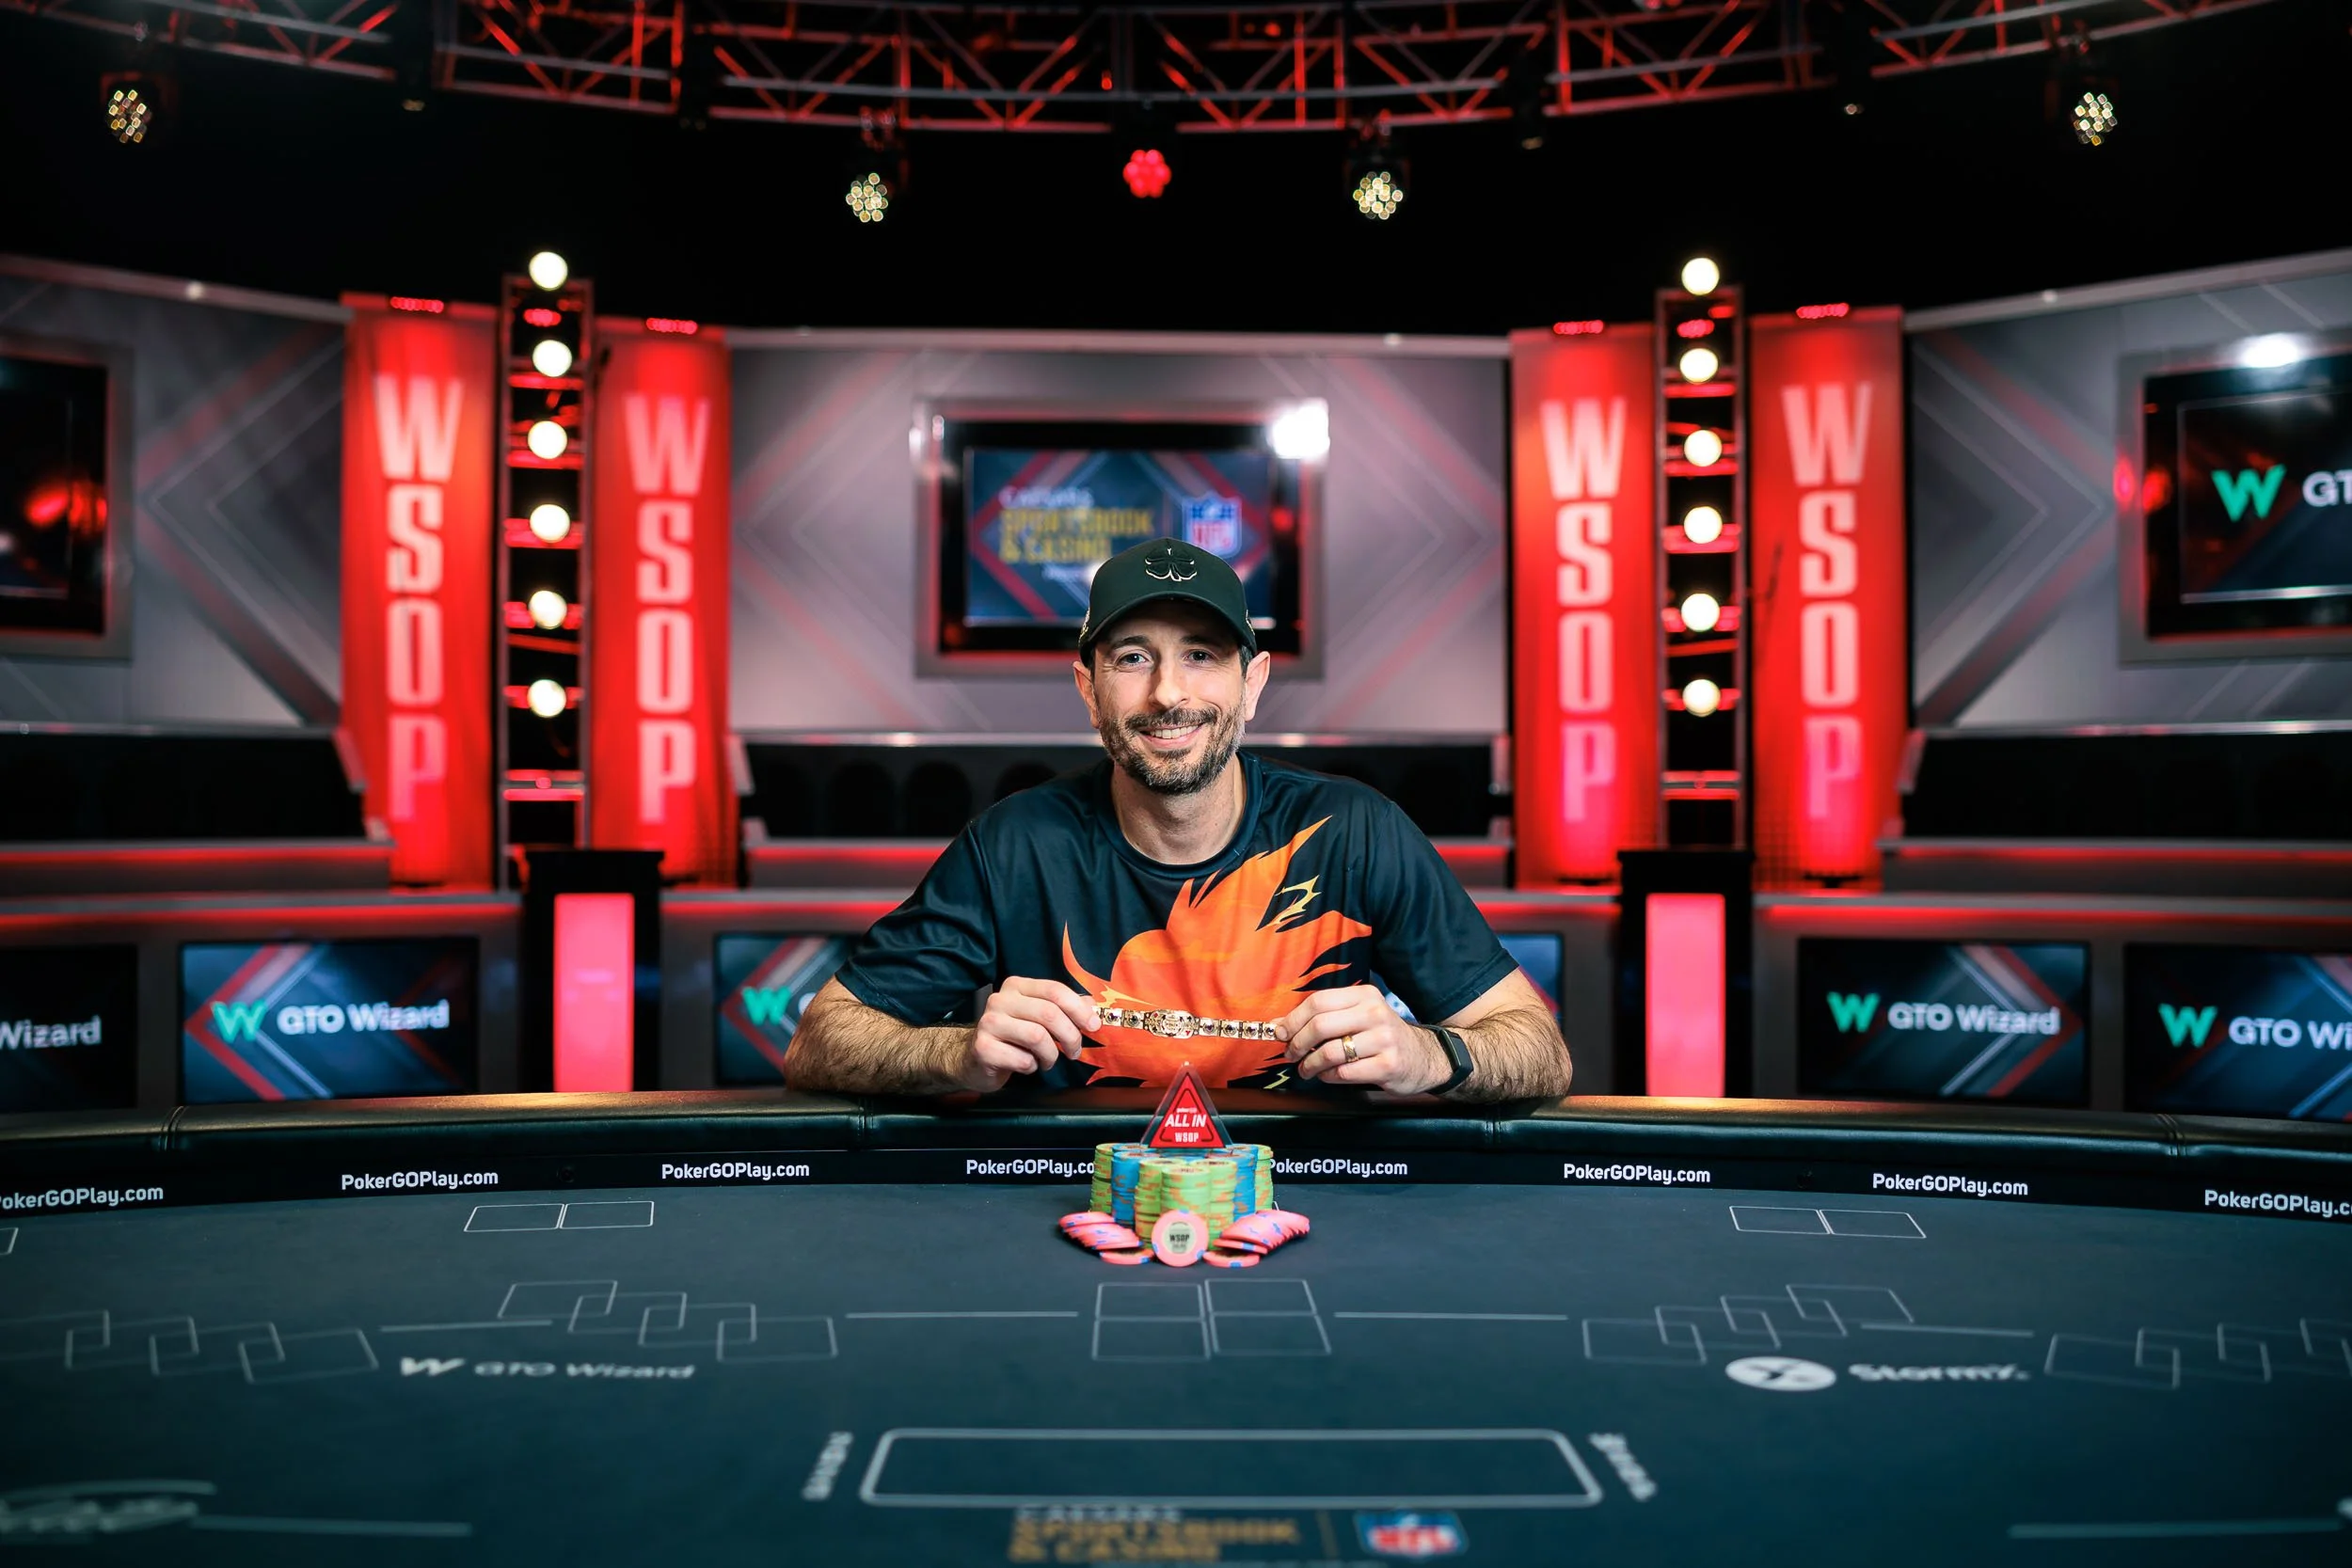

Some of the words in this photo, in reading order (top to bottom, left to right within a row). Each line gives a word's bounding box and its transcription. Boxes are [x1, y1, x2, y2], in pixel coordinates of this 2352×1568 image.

[2302, 469, 2352, 508] GT
[376, 373, 464, 822] WSOP
[625, 394, 711, 825] WSOP
[1539, 396, 1627, 823] WSOP
[1782, 382, 1872, 819] WSOP
[277, 1005, 345, 1035] GTO
[347, 999, 450, 1033] Wizard
[1887, 1002, 1954, 1032] GTO
[1956, 1006, 2060, 1036] Wizard
[0, 1014, 102, 1050] Wizard
[2228, 1016, 2302, 1048] GTO
[1165, 1114, 1189, 1128] ALL
[1191, 1114, 1207, 1128] IN
[1174, 1132, 1200, 1143] WSOP
[342, 1171, 499, 1191] PokerGOPlay.com
[661, 1163, 810, 1181] PokerGOPlay.com
[966, 1159, 1095, 1178] PokerGOPlay.co
[1564, 1163, 1710, 1185] PokerGOPlay.com
[0, 1186, 165, 1211] okerGOPlay.com
[1872, 1173, 2028, 1196] PokerGOPlay.com
[2204, 1189, 2352, 1218] PokerGOPlay.c
[566, 1363, 694, 1379] Wizard
